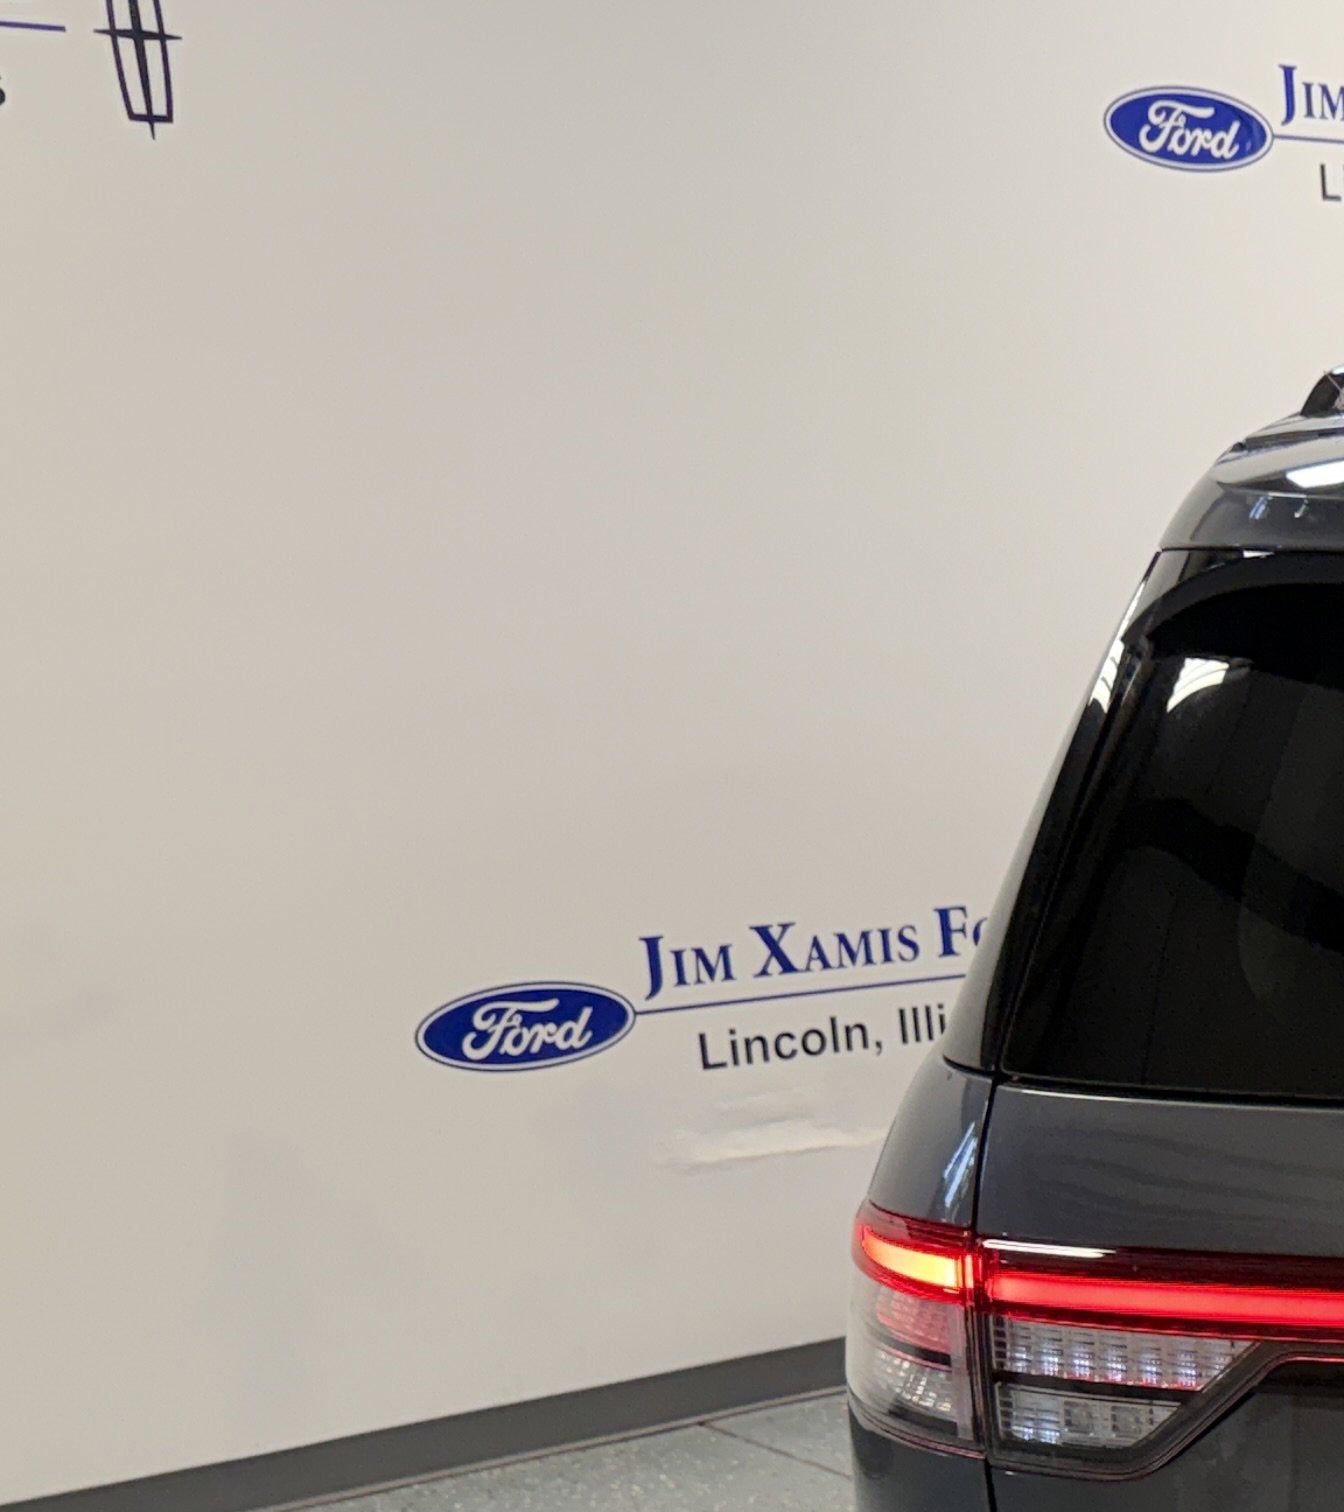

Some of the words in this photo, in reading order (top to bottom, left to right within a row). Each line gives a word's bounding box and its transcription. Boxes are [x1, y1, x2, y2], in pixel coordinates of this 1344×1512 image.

[1138, 100, 1241, 161] Ford
[638, 935, 736, 1001] JIM
[748, 921, 921, 978] XAMIS
[462, 998, 595, 1061] Ford
[697, 1015, 884, 1071] Lincoln,
[898, 1003, 948, 1046] Illi
